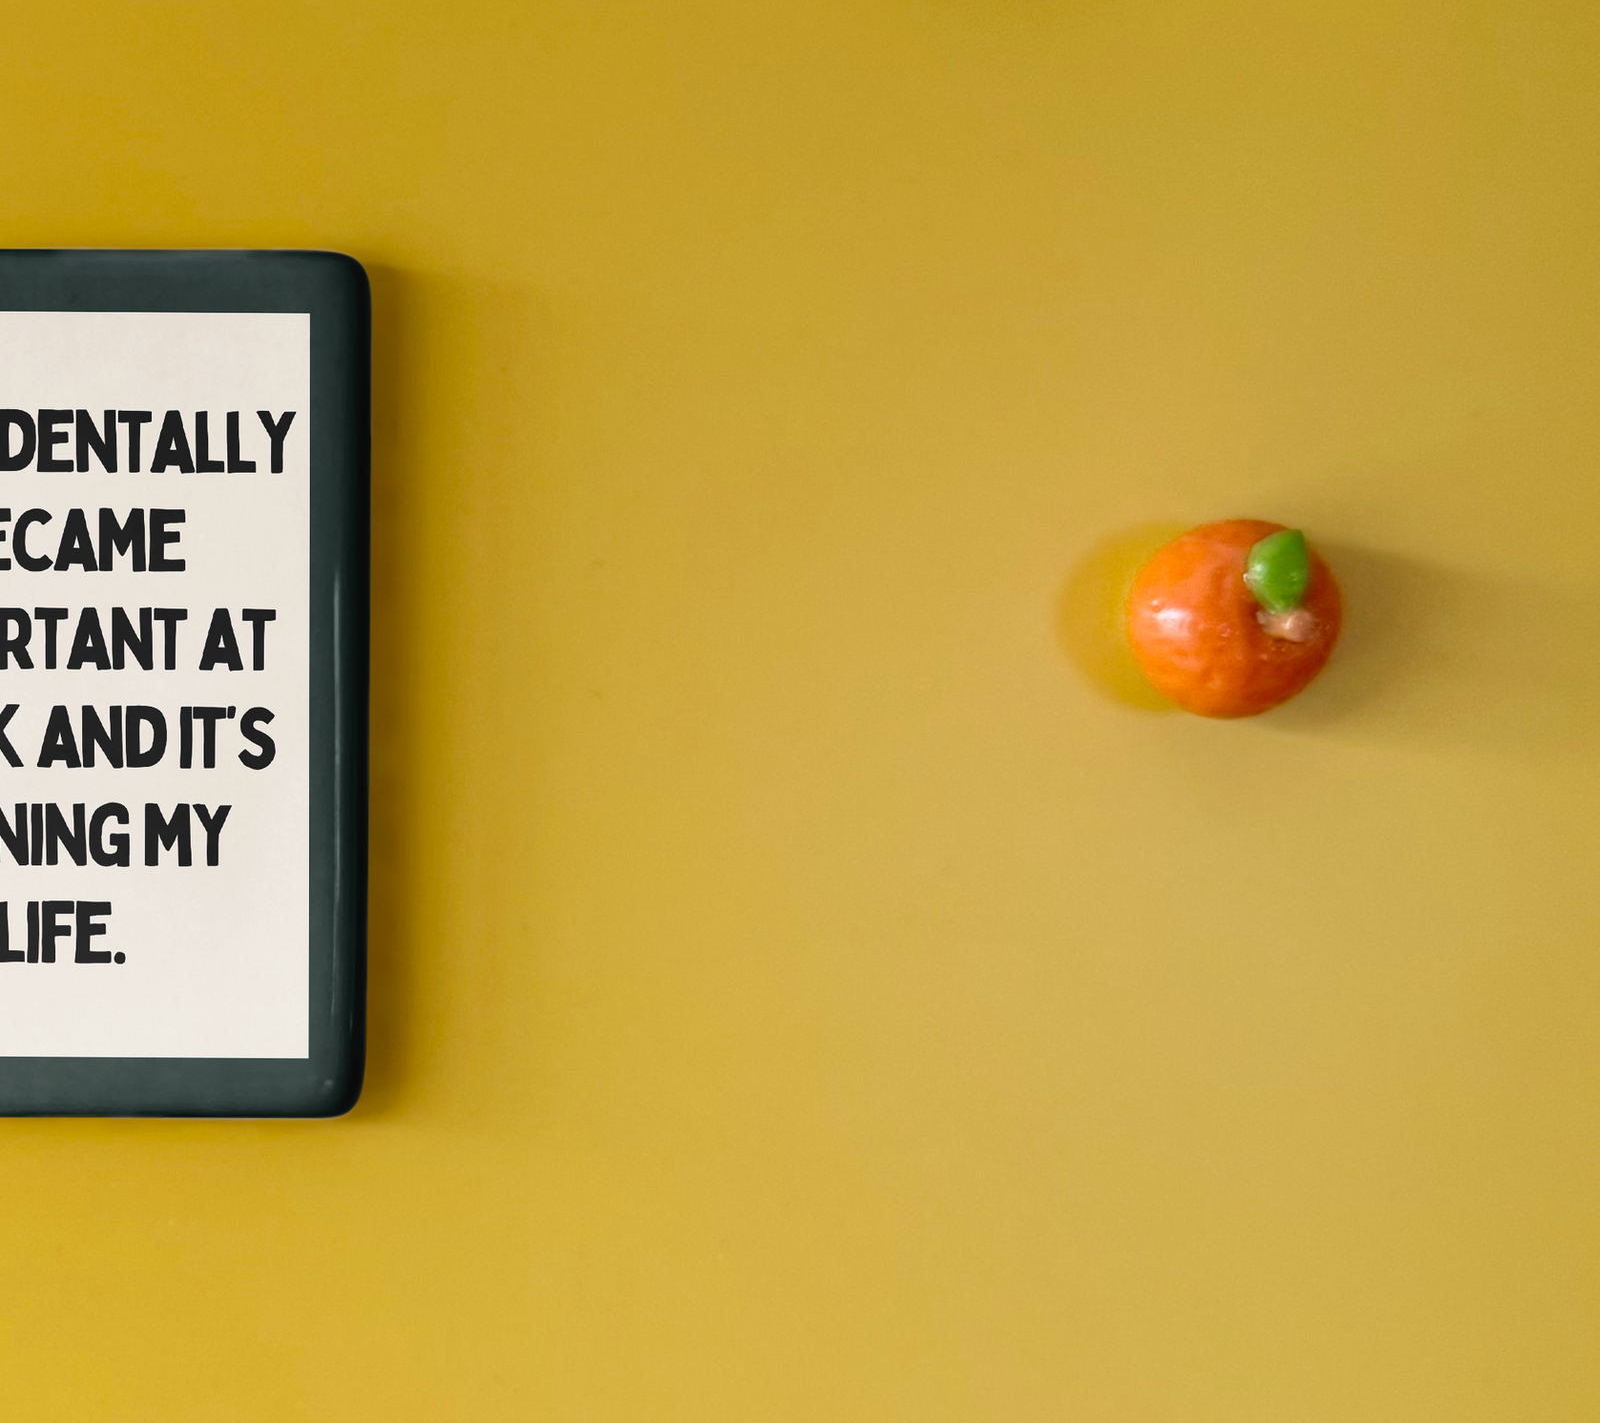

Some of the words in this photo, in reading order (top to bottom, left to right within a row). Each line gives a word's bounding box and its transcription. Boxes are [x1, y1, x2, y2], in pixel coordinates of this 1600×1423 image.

[198, 607, 277, 672] AT
[36, 704, 168, 769] AND
[179, 705, 276, 771] IT'S
[144, 802, 233, 867] MY
